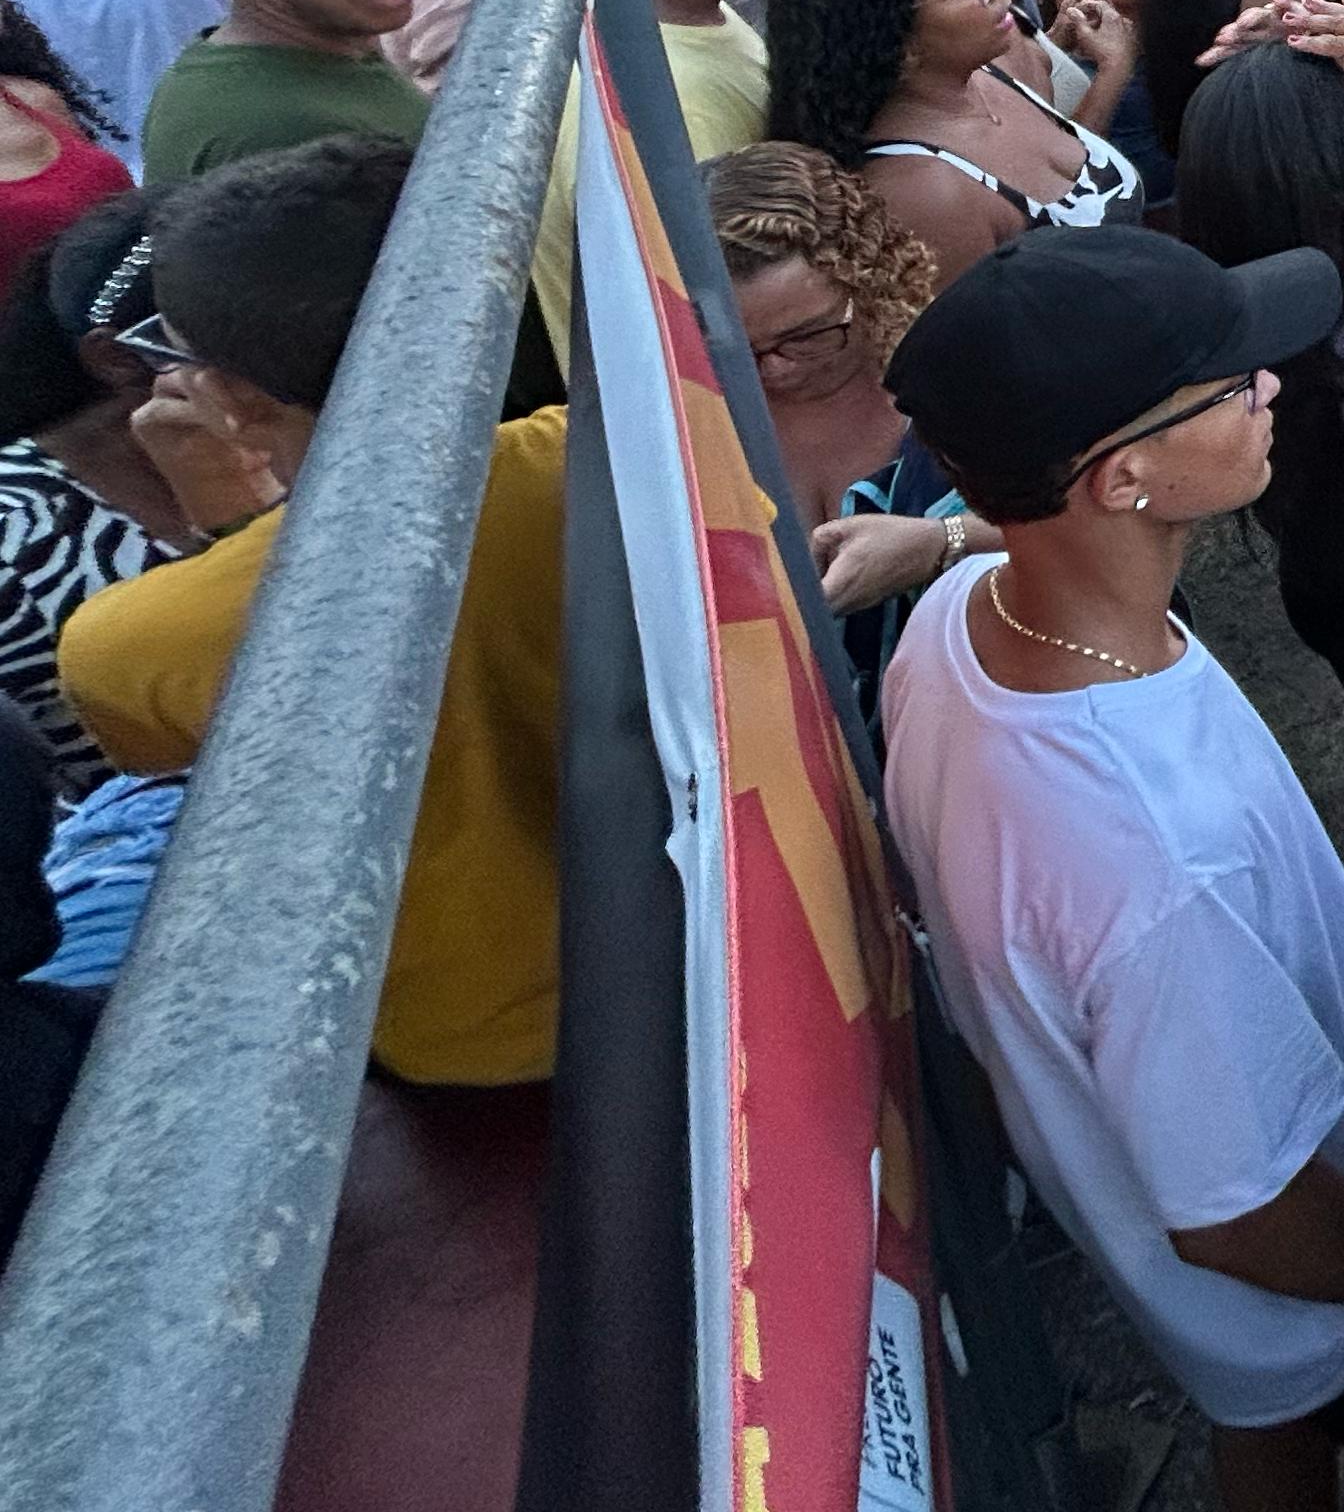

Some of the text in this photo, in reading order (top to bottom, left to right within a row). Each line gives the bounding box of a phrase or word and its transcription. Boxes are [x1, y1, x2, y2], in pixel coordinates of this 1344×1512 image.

[867, 1356, 905, 1481] FUTURO
[877, 1324, 925, 1496] PRA GENTE
